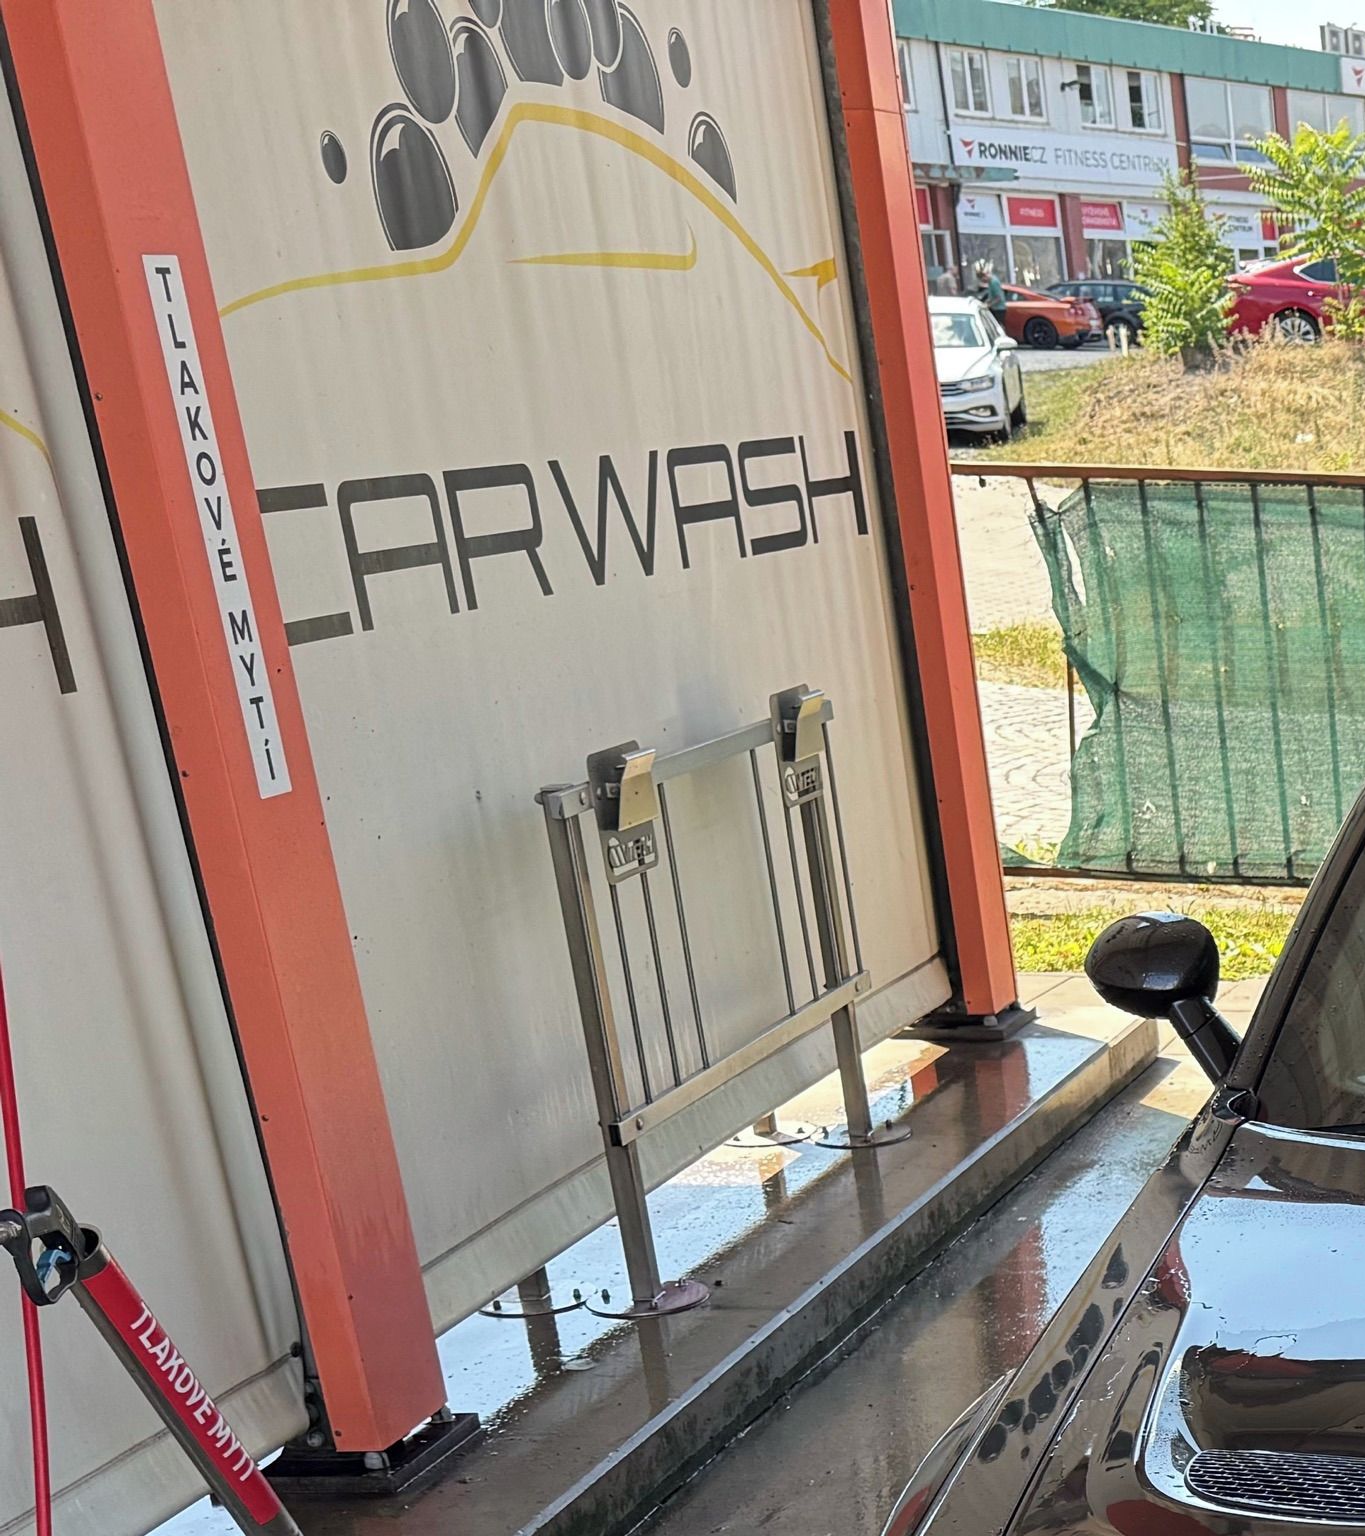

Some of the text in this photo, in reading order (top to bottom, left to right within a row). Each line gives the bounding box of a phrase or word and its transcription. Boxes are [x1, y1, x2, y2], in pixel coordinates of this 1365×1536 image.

[1054, 147, 1108, 169] FITNESS
[155, 266, 276, 781] TLAKOVÉ MYTÍ
